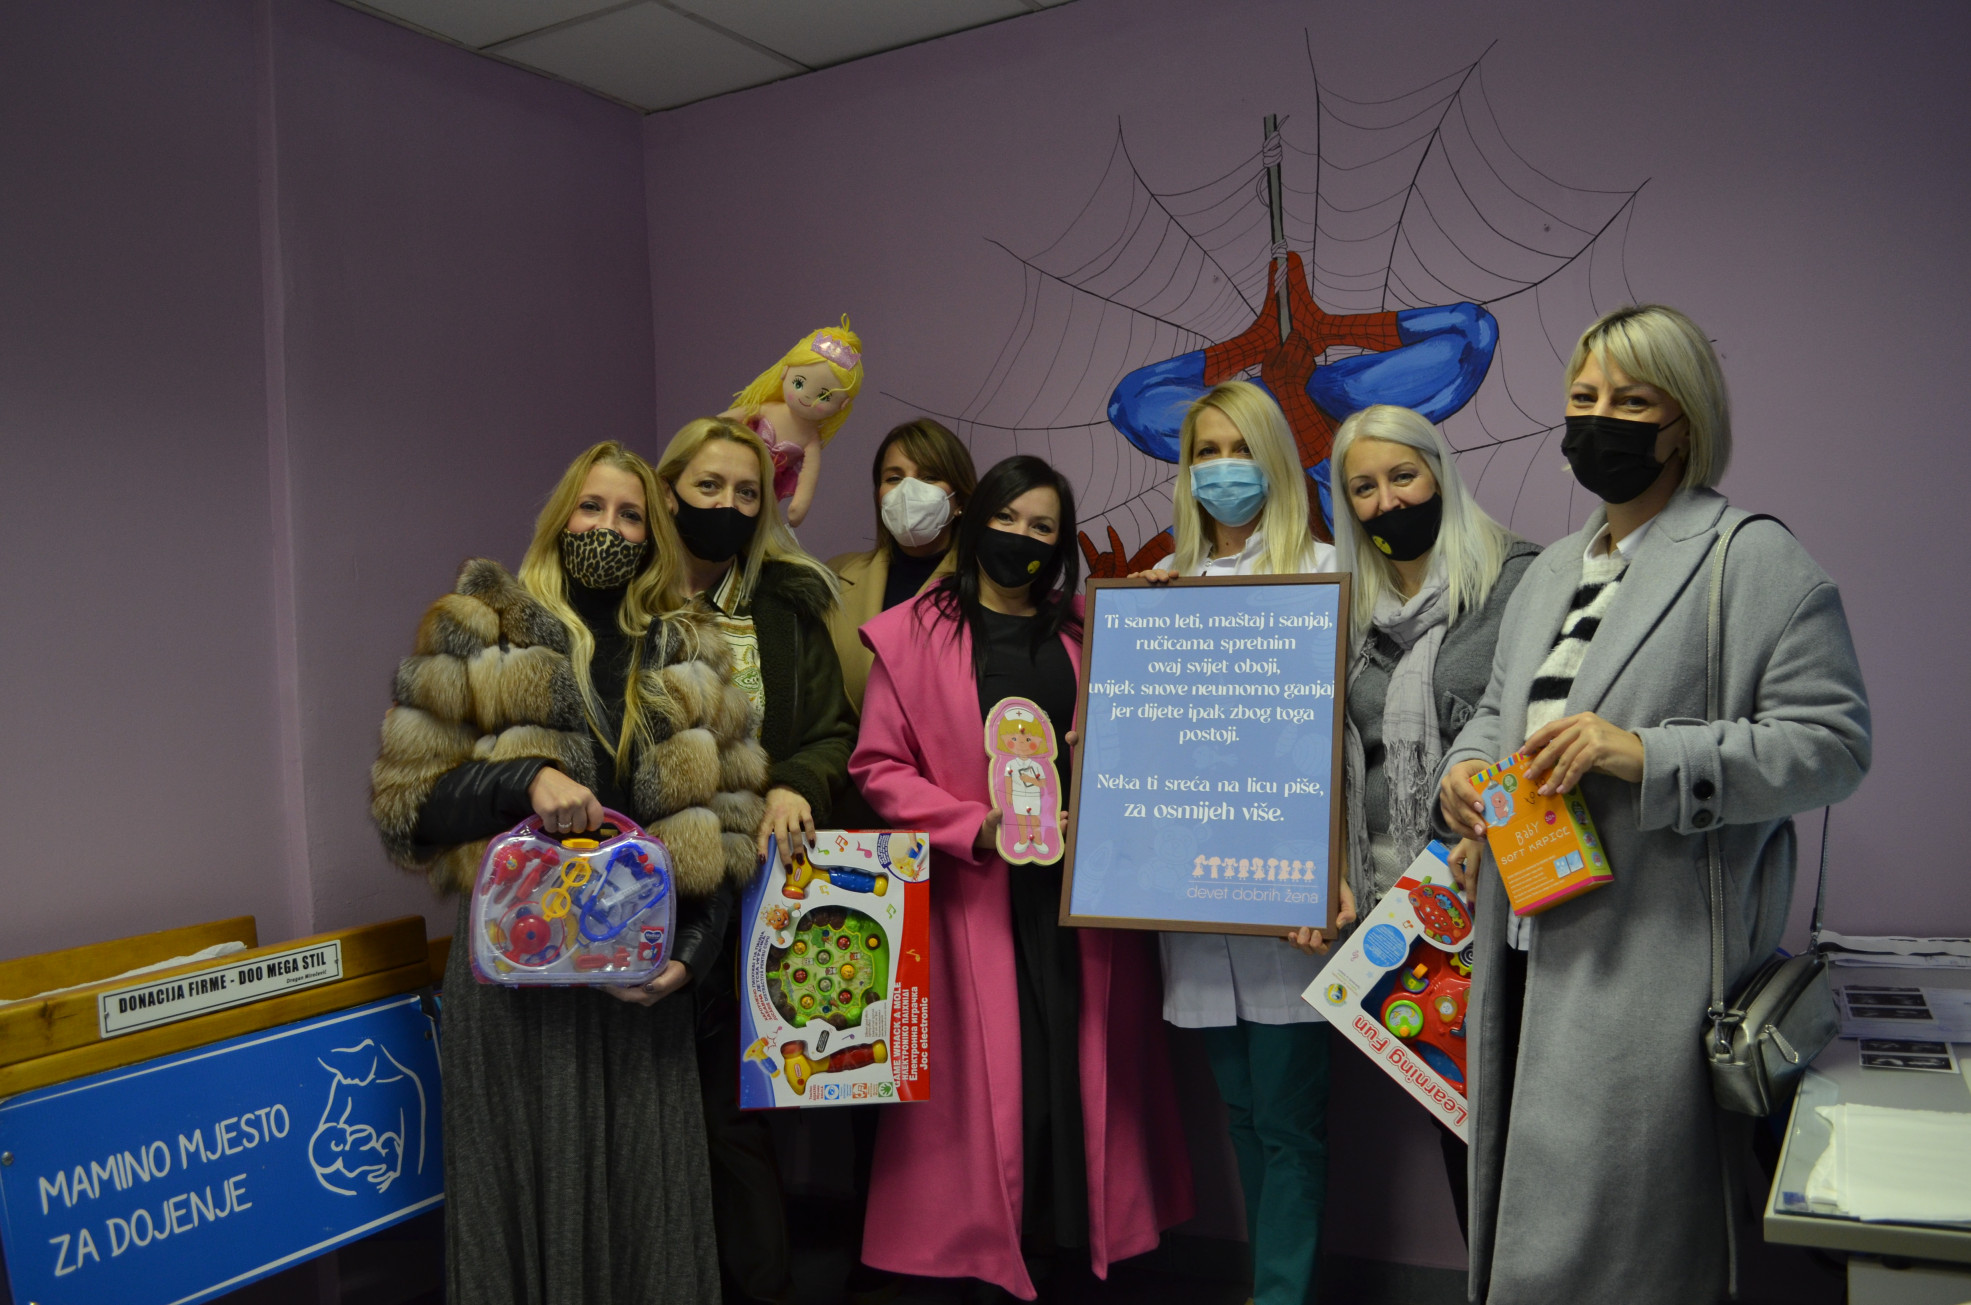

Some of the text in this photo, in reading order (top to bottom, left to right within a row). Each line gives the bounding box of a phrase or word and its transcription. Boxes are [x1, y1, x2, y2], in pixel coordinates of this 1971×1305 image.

[1104, 611, 1333, 631] Ti samo leti, maštaj i sanjaj,
[1135, 634, 1296, 654] ručicama spretnim
[1147, 657, 1281, 677] ovaj svijet oboji,
[1088, 679, 1135, 698] uvijek
[1140, 683, 1189, 696] snove
[1283, 679, 1335, 700] ganjaj
[1110, 702, 1315, 725] jer dijete ipak zbog toga
[1178, 726, 1240, 745] postoji.
[1097, 773, 1324, 798] Neka ti sreća na licu piše,
[1123, 800, 1285, 825] za osmijeh više.
[1501, 848, 1525, 865] SOFT
[1186, 884, 1319, 904] devet dobrih žena
[118, 985, 185, 1014] DONACIJA
[188, 970, 227, 997] FIRME
[239, 965, 264, 986] DOO
[267, 957, 299, 980] MEGA
[302, 951, 327, 972] STIL
[893, 981, 902, 1009] MOLE
[893, 1022, 901, 1057] WHACK
[909, 986, 920, 1081] Електронна играчка
[919, 997, 929, 1070] Joc electronic
[893, 1059, 901, 1088] GAME
[1353, 1015, 1468, 1127] Learning Fun
[38, 1103, 290, 1215] MAMINO MJESTO
[49, 1173, 252, 1277] ZA DOJENJE
